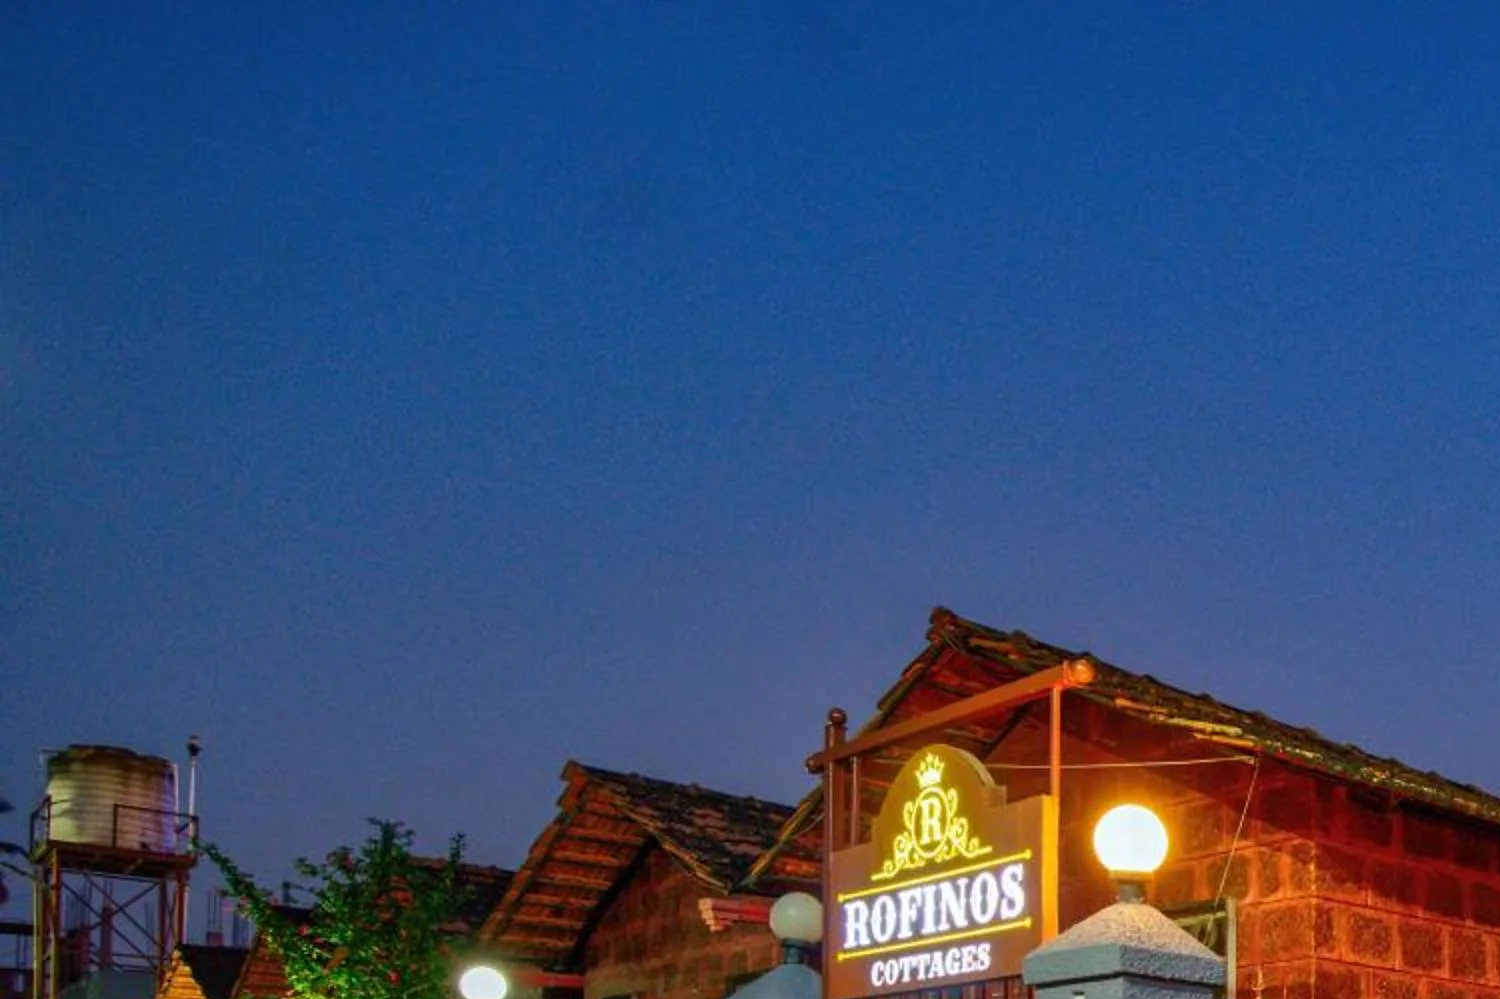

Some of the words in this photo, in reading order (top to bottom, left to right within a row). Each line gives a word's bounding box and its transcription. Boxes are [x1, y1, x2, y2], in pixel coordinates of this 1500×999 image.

[920, 797, 943, 845] R
[843, 863, 1025, 949] ROFINOS
[871, 943, 991, 986] COTTAGES
